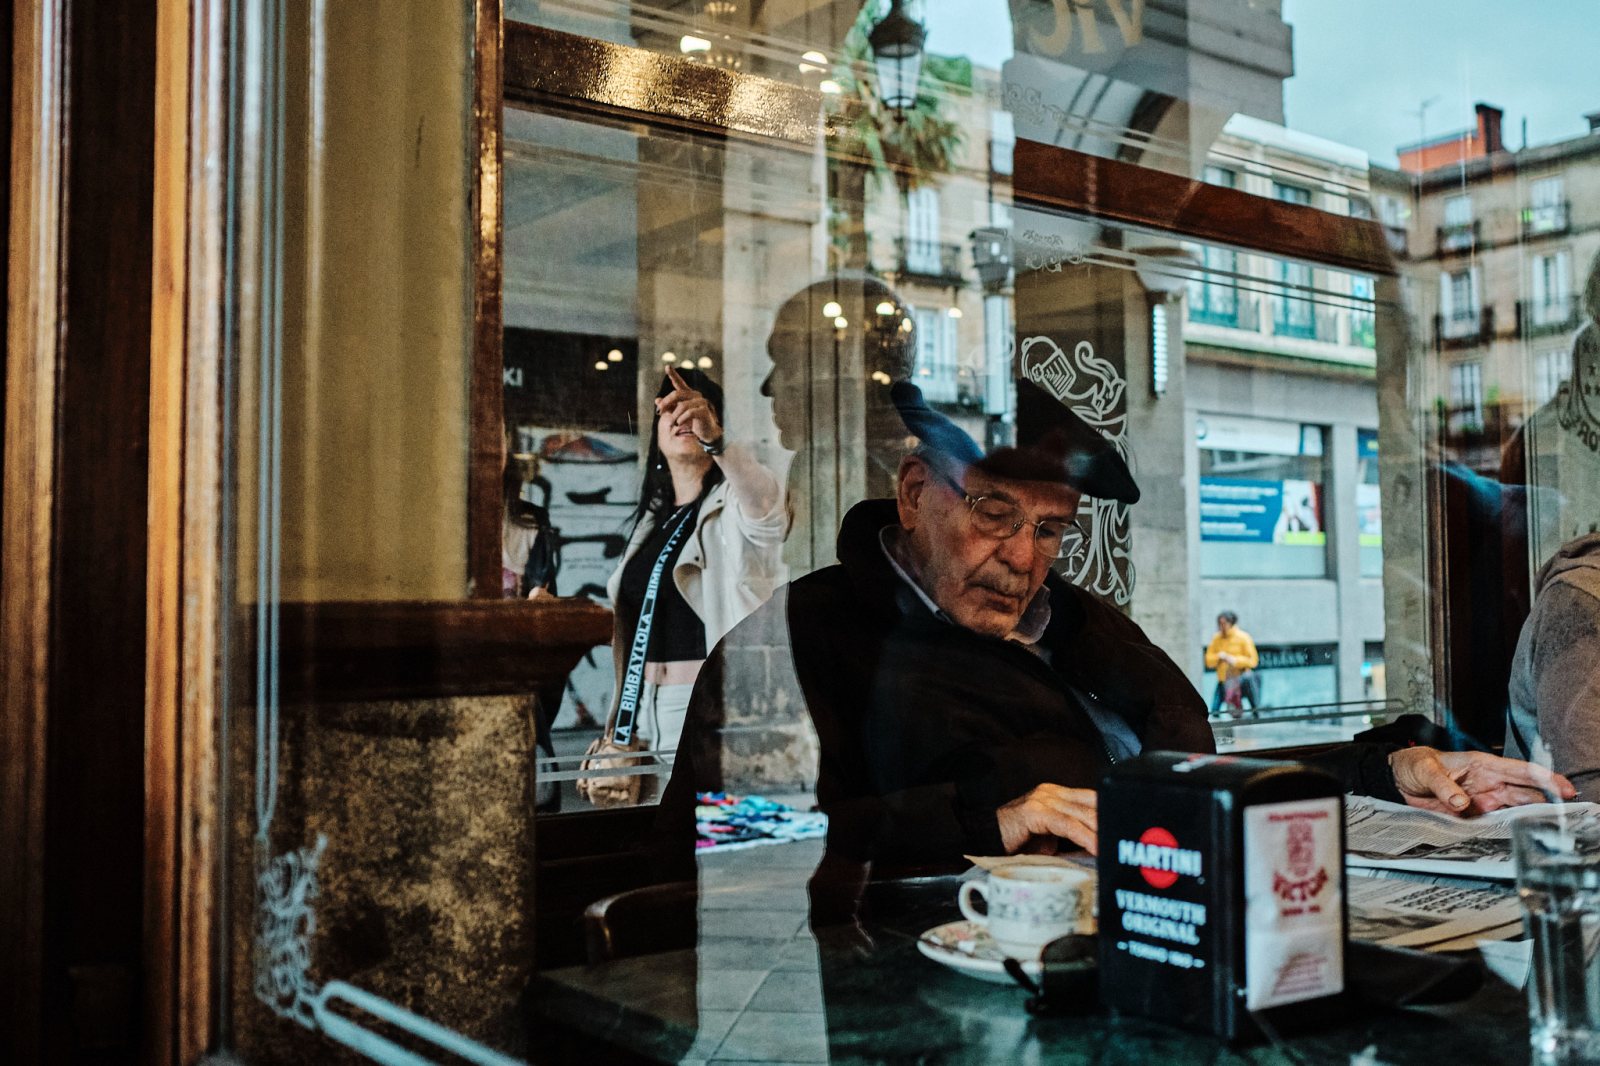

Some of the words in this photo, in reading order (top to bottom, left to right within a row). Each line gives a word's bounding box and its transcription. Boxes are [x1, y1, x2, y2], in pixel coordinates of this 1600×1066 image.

[620, 611, 652, 712] BIMBAYLOLA
[1118, 839, 1202, 877] MARTINI
[1116, 889, 1206, 926] VERMOUTH
[1121, 910, 1200, 945] ORIGINAL
